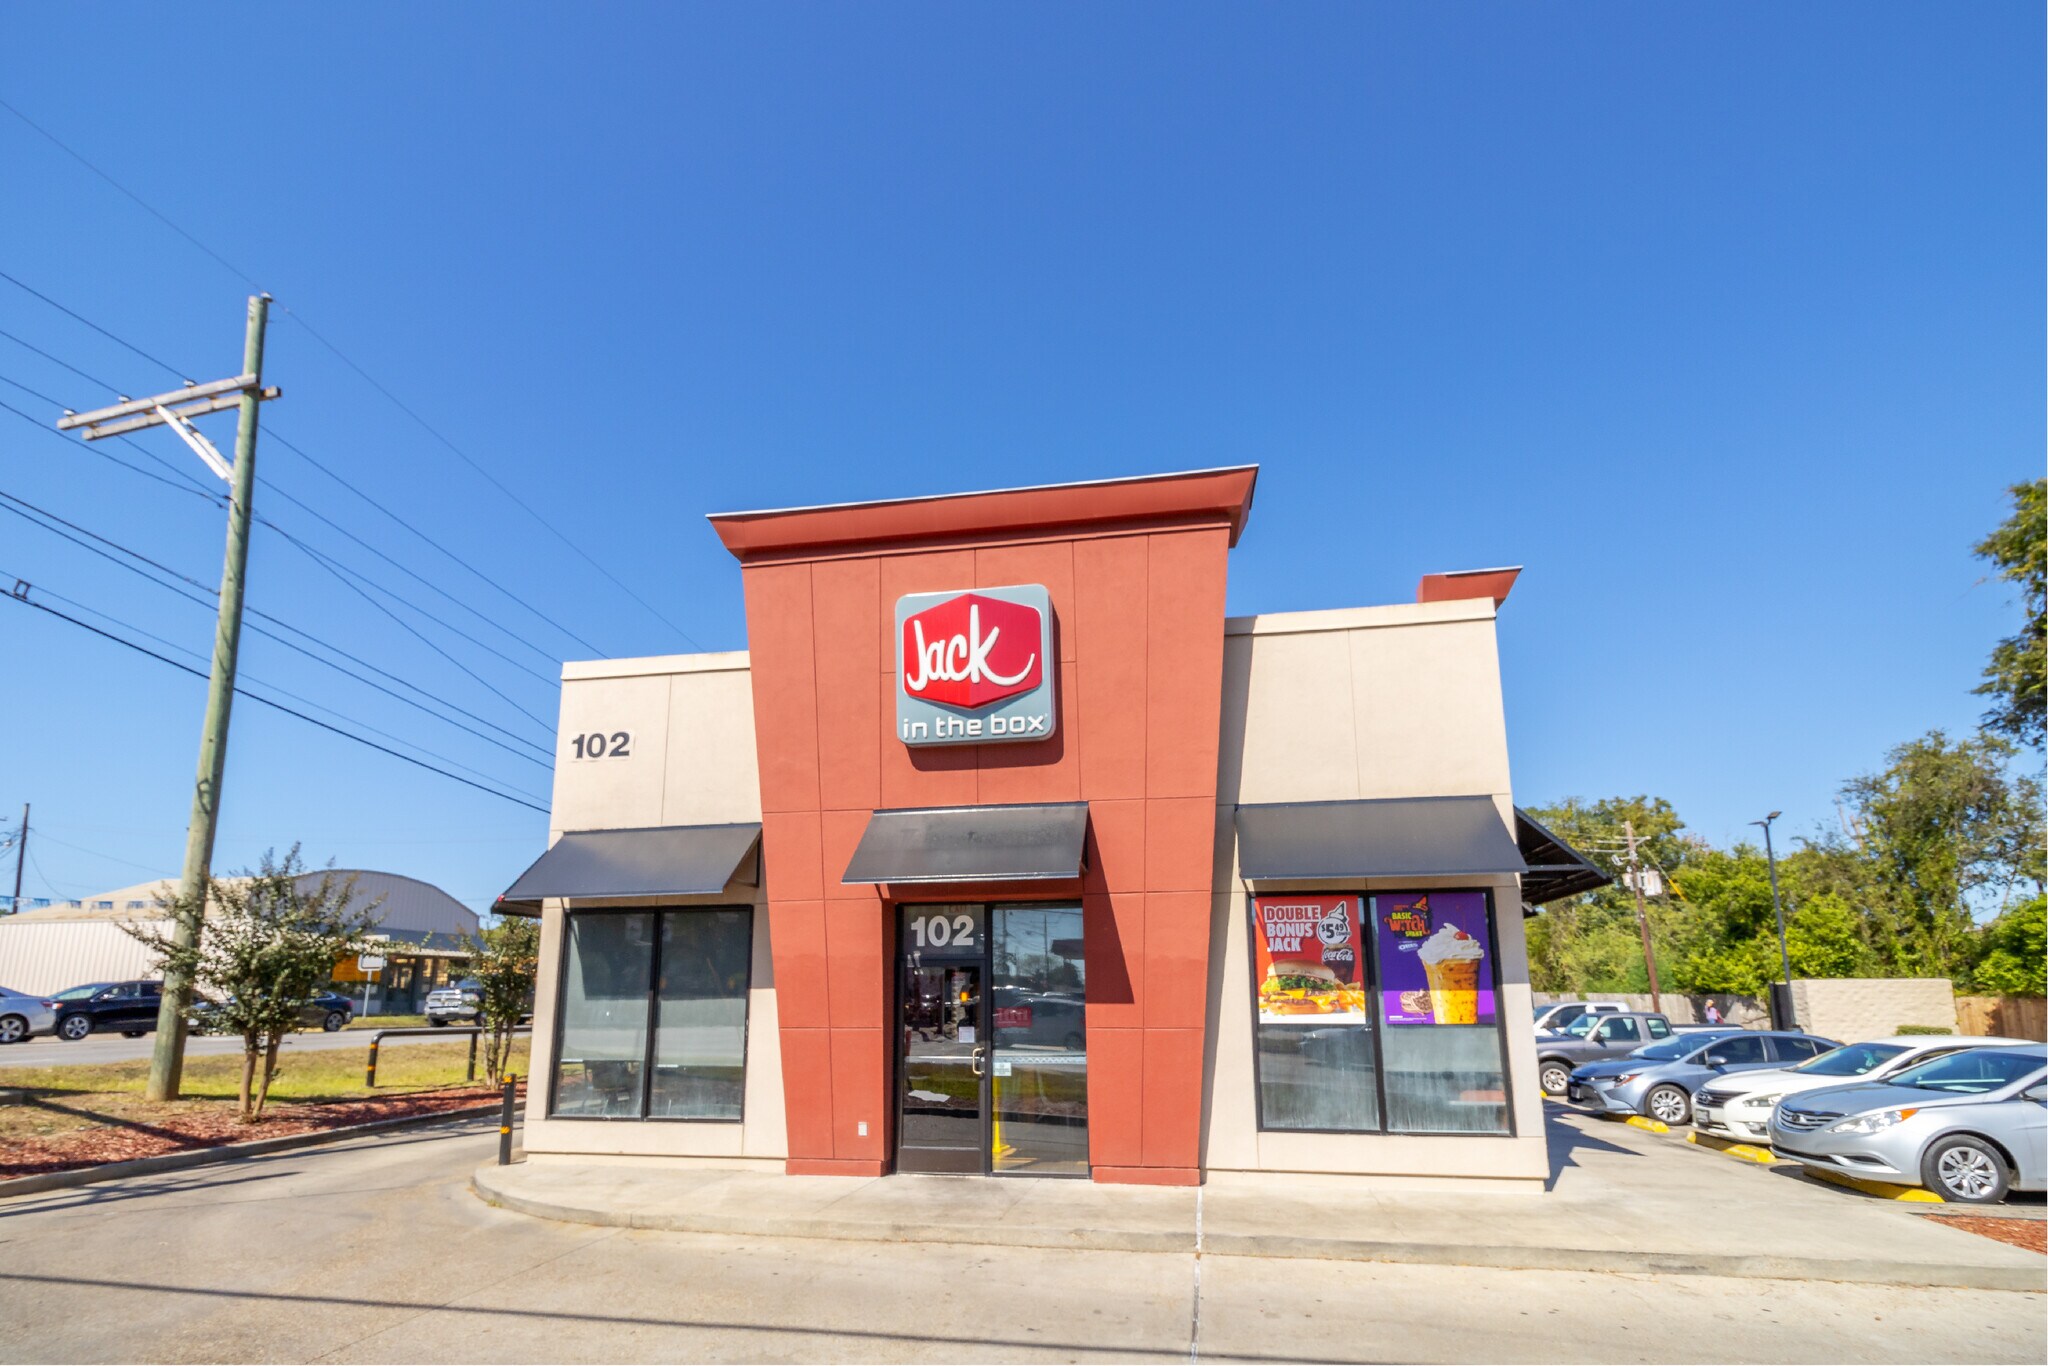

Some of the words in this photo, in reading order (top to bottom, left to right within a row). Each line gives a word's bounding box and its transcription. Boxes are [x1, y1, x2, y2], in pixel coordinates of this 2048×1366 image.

[907, 604, 1035, 691] Jack
[904, 719, 928, 739] in
[936, 716, 983, 737] the
[990, 714, 1046, 736] box
[571, 732, 630, 759] 102
[1266, 907, 1320, 921] DOUBLE
[1391, 912, 1412, 920] BASIC
[911, 915, 974, 947] 102
[1266, 922, 1313, 937] BONUS
[1266, 937, 1302, 953] JACK
